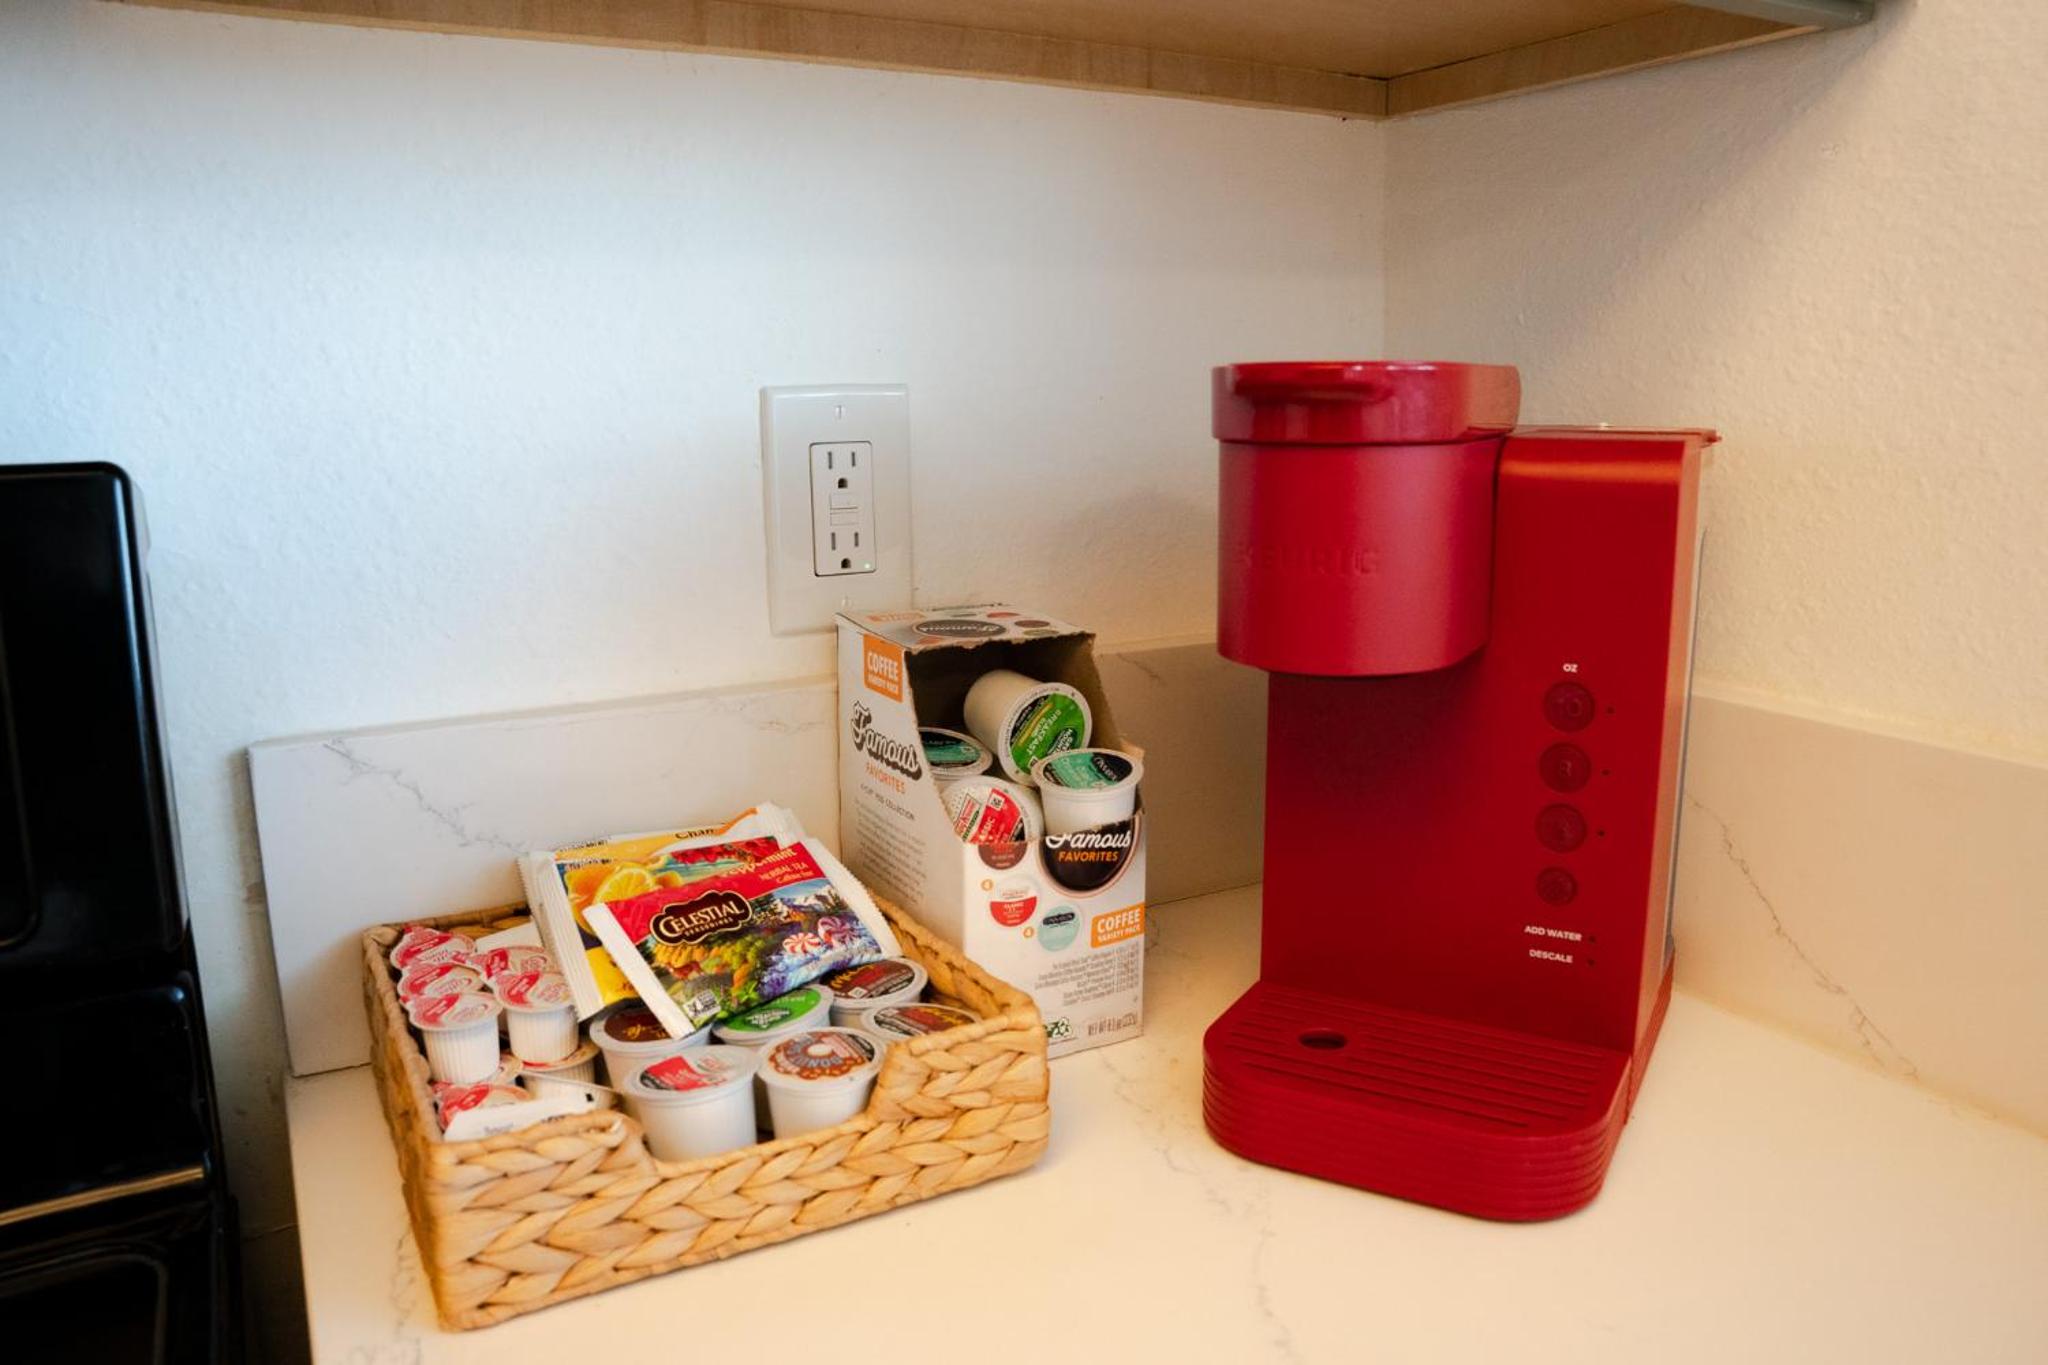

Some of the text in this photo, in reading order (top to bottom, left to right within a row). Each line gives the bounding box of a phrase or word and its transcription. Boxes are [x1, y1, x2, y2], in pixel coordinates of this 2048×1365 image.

[867, 651, 899, 679] COFFEE
[851, 700, 922, 781] Famous
[1058, 850, 1118, 863] FAVORITES
[658, 900, 745, 938] CELESTIAL
[1097, 908, 1141, 933] COFFEE
[1524, 925, 1582, 942] ADD WATER
[1529, 949, 1573, 963] DESCALE
